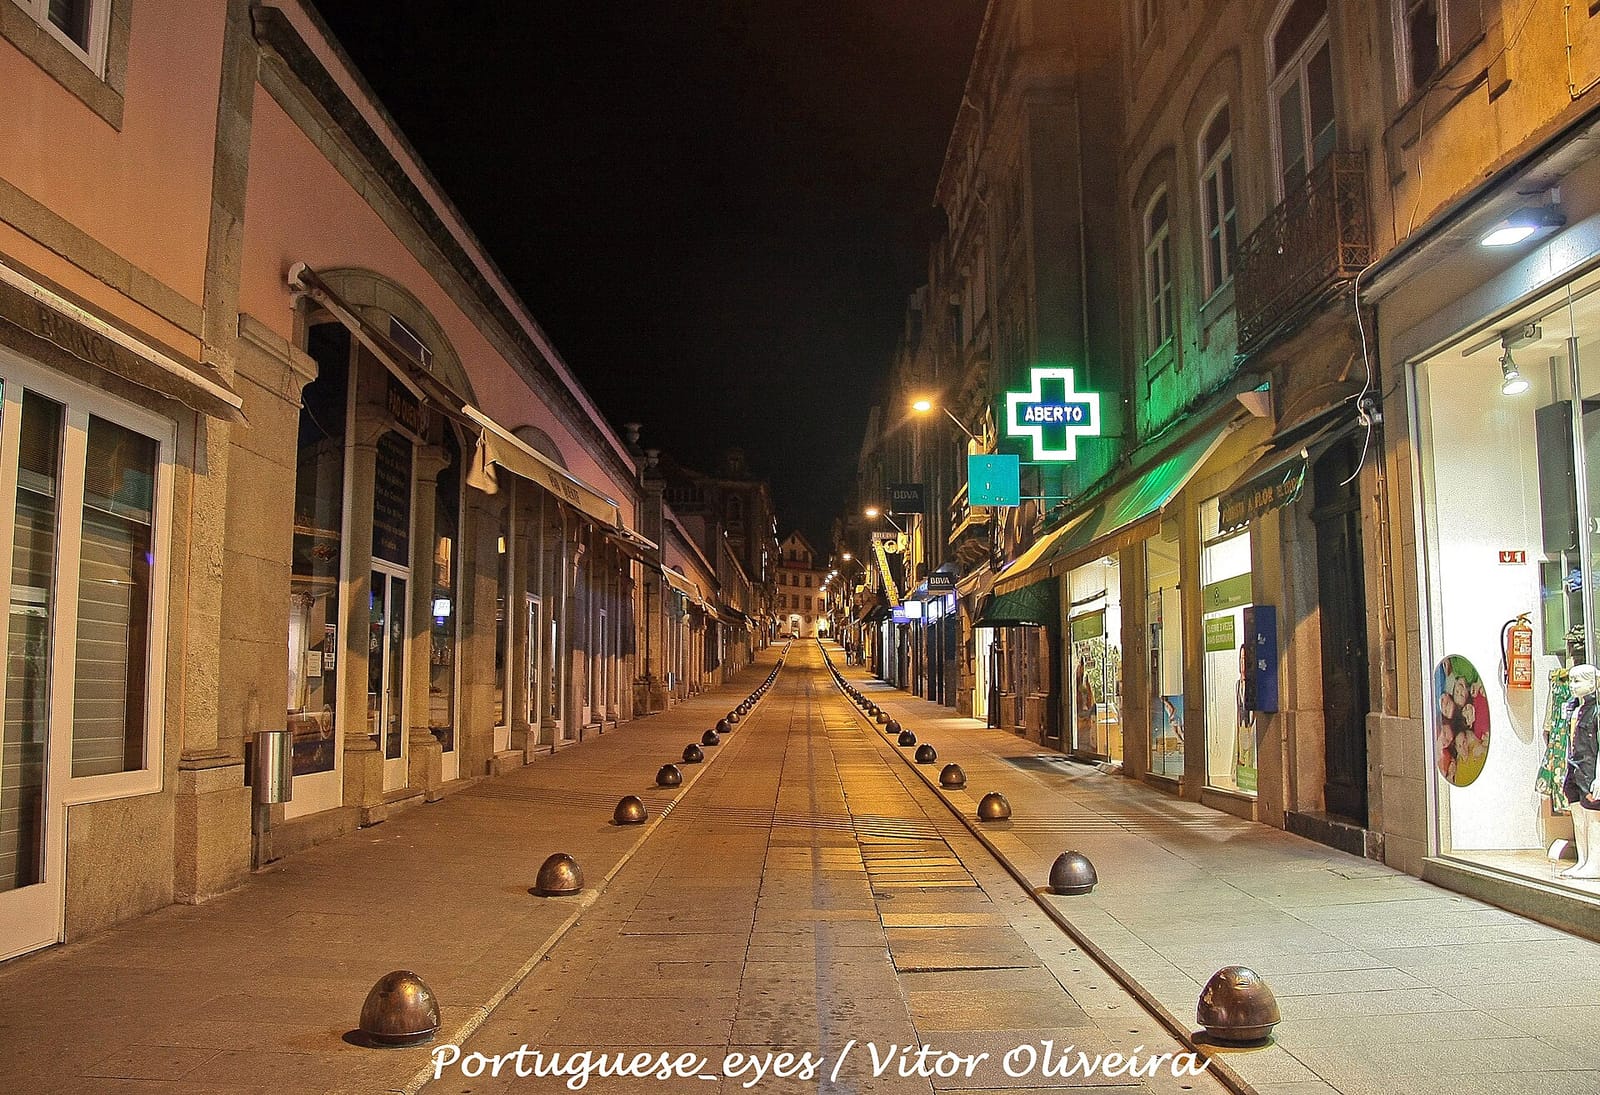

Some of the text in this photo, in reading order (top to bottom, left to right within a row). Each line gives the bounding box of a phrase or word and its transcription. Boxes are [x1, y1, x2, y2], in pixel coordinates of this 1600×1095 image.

[1024, 406, 1082, 422] ABERTO
[893, 490, 919, 500] BBVA
[930, 577, 950, 585] BBVA
